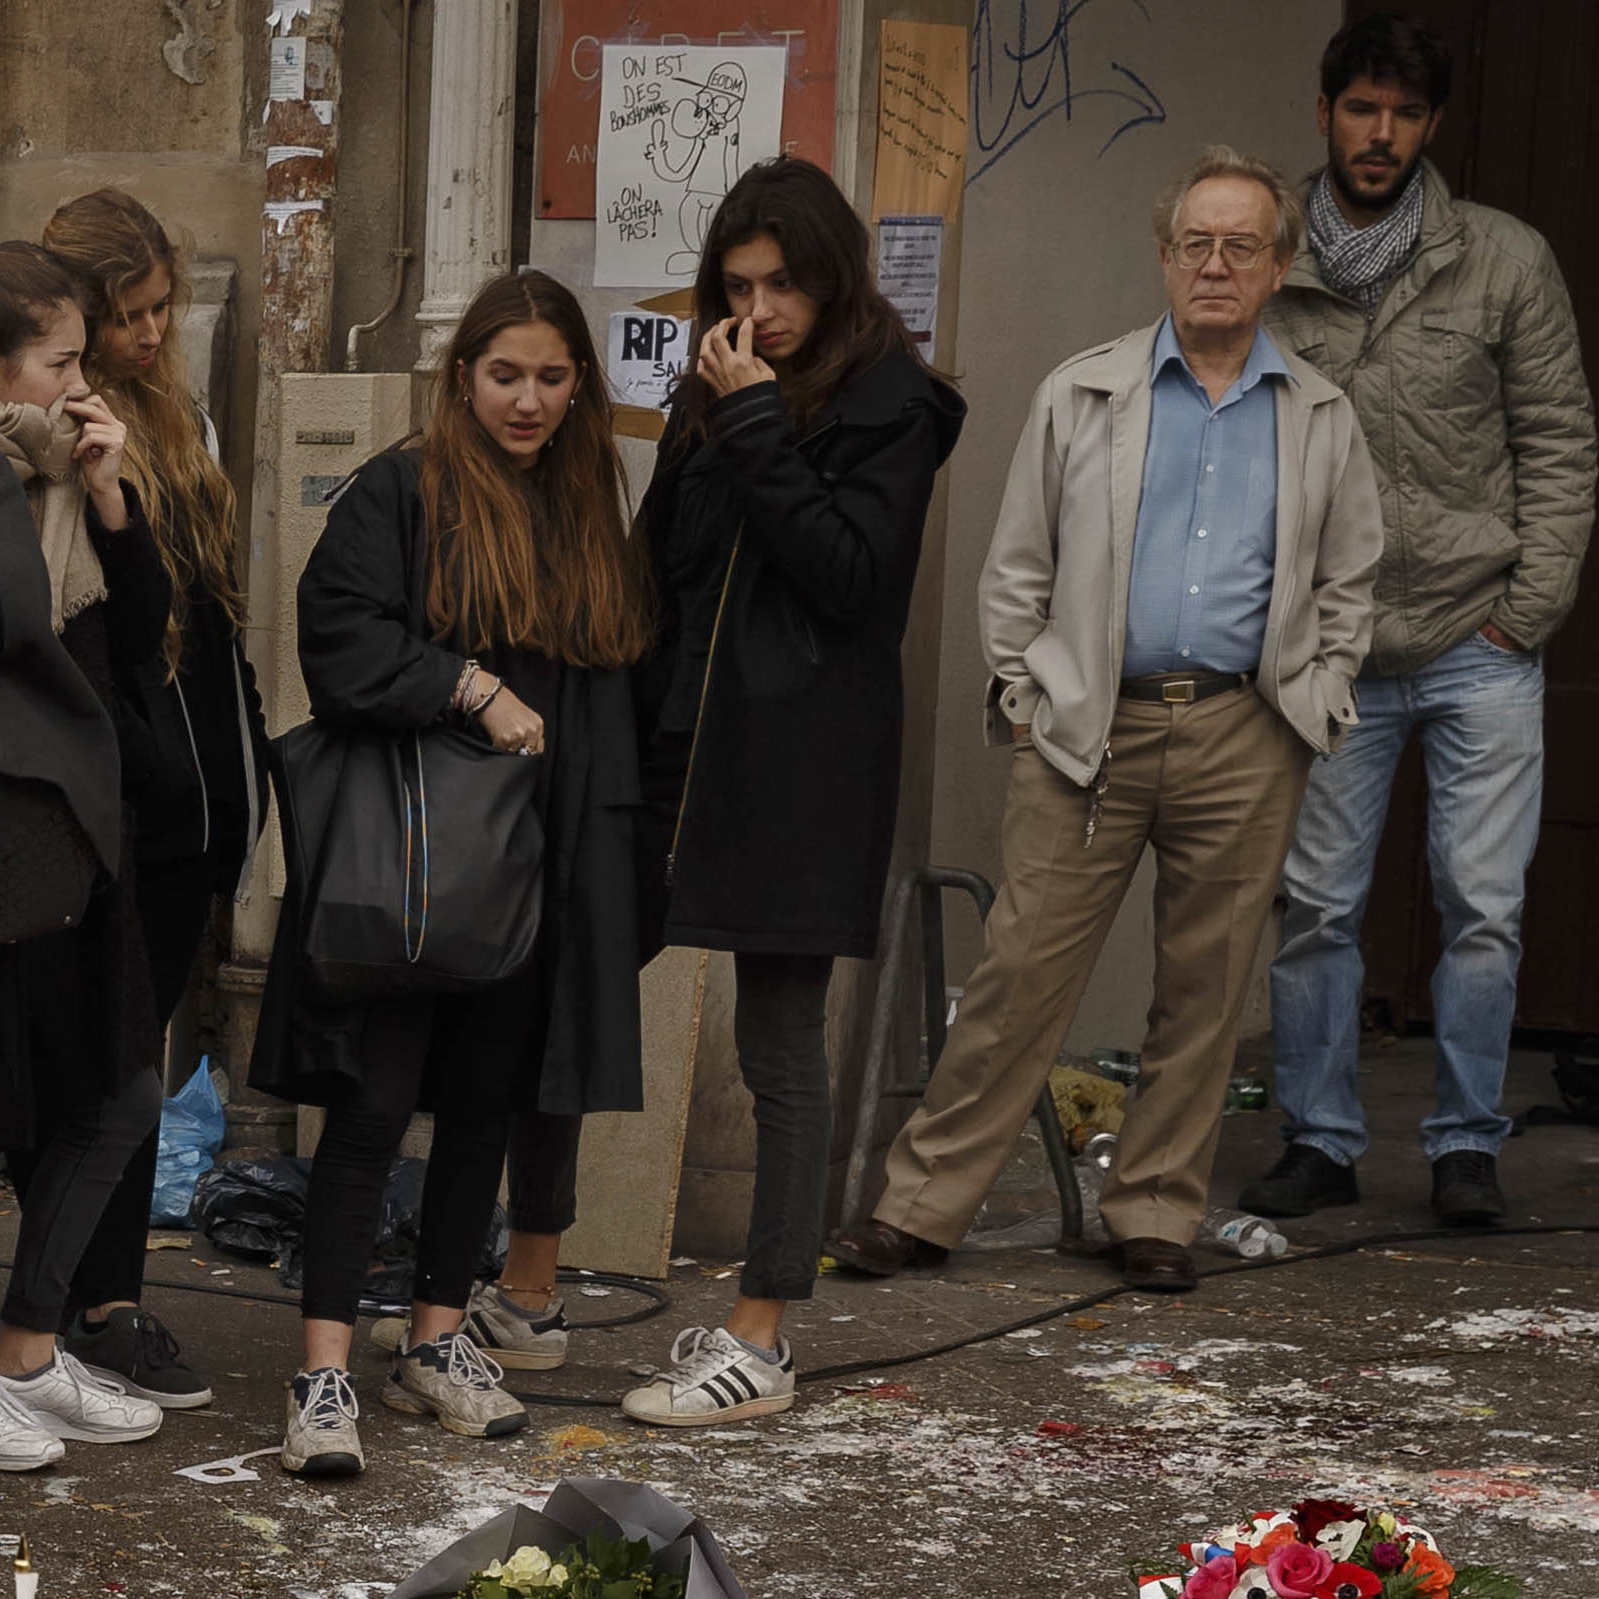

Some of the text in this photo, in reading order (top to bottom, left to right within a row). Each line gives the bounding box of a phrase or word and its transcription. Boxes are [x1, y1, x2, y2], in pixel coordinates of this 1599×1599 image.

[622, 57, 646, 80] ON
[656, 53, 687, 76] EST
[624, 82, 662, 109] DES
[621, 184, 642, 205] ON
[621, 317, 678, 361] RIP
